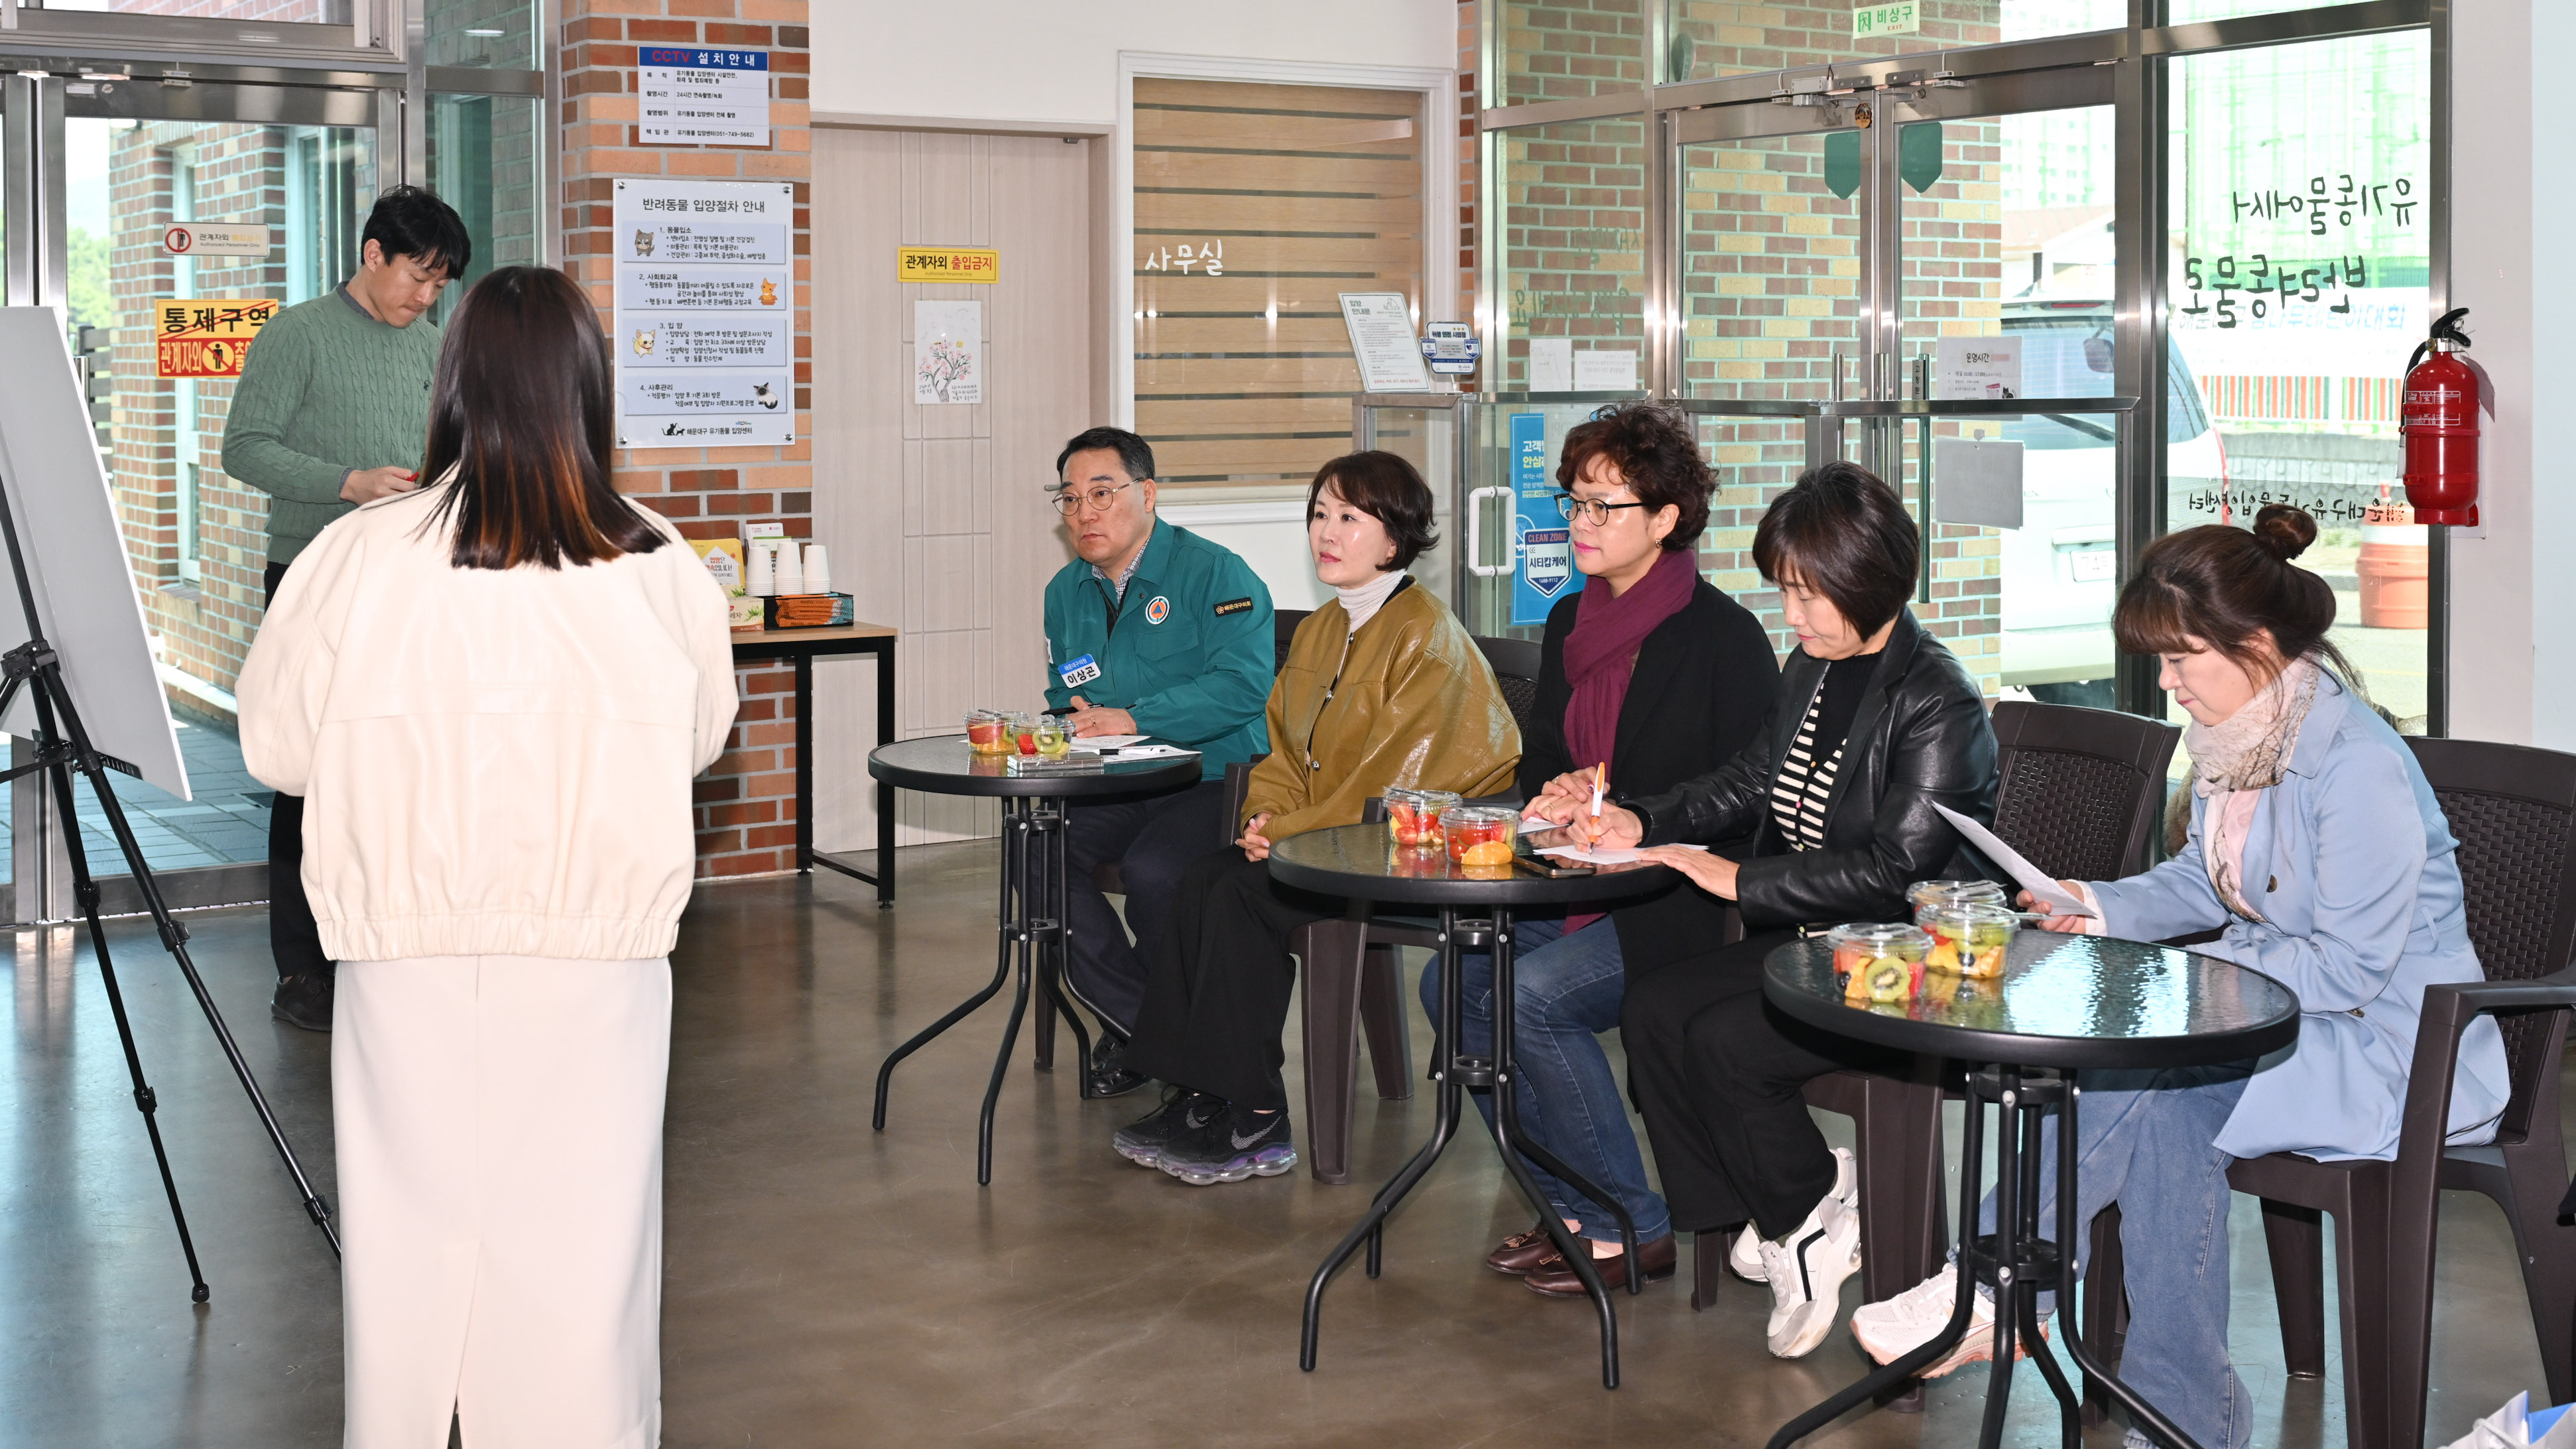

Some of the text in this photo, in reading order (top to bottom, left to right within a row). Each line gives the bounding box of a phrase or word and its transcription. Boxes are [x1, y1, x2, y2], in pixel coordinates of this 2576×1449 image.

[1876, 5, 1912, 25] 비상구
[652, 50, 690, 62] CCTV
[643, 198, 765, 213] 반려동물 입양절차 안내
[906, 255, 992, 271] 관계자외 출입금지
[1144, 239, 1223, 277] 사무실
[163, 308, 270, 333] 통제구역
[160, 341, 250, 373] 관계자외 출
[1967, 353, 1989, 363] 운영시간
[1522, 440, 1544, 452] 고객
[1528, 533, 1567, 542] CLEAN ZONE
[1067, 666, 1096, 684] 이상곤
